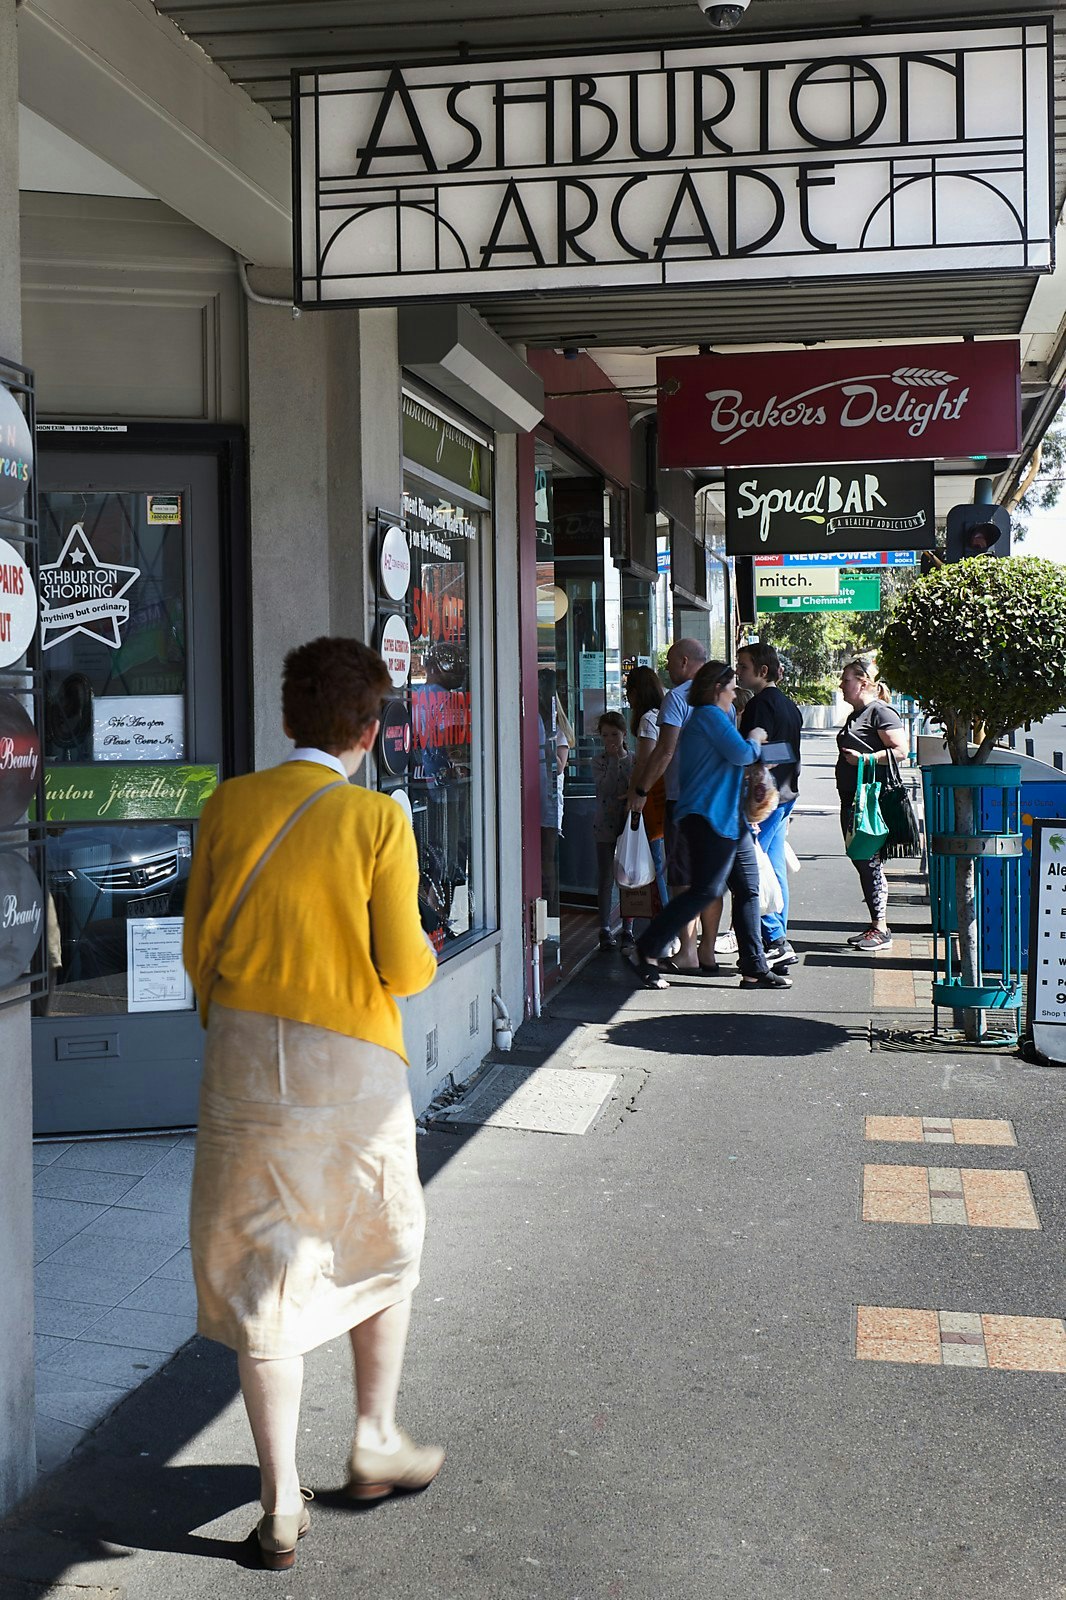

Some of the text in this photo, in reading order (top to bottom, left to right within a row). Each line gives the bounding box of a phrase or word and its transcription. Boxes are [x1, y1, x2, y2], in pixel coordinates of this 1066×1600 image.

[356, 52, 965, 177] ASHBURTON
[480, 162, 838, 269] ARCADE
[705, 384, 970, 444] Bakers Delight
[837, 518, 919, 529] A HEALTHY ADDICTION
[789, 551, 877, 561] NEWSPOWER
[40, 569, 118, 584] ASHBURTON
[760, 573, 812, 587] mitch.
[44, 584, 113, 599] SHOPPING
[802, 596, 852, 605] Chemmart
[76, 607, 90, 617] but
[92, 603, 127, 613] ordinary
[441, 592, 465, 644] OFF
[127, 715, 146, 728] Are
[147, 719, 164, 730] open
[411, 691, 472, 750] TOREWIDE
[103, 733, 175, 745] Please Come In
[0, 736, 38, 780] Beauty
[97, 777, 188, 816] jewellery
[2, 894, 42, 935] Beauty
[1042, 1009, 1061, 1018] Shop
